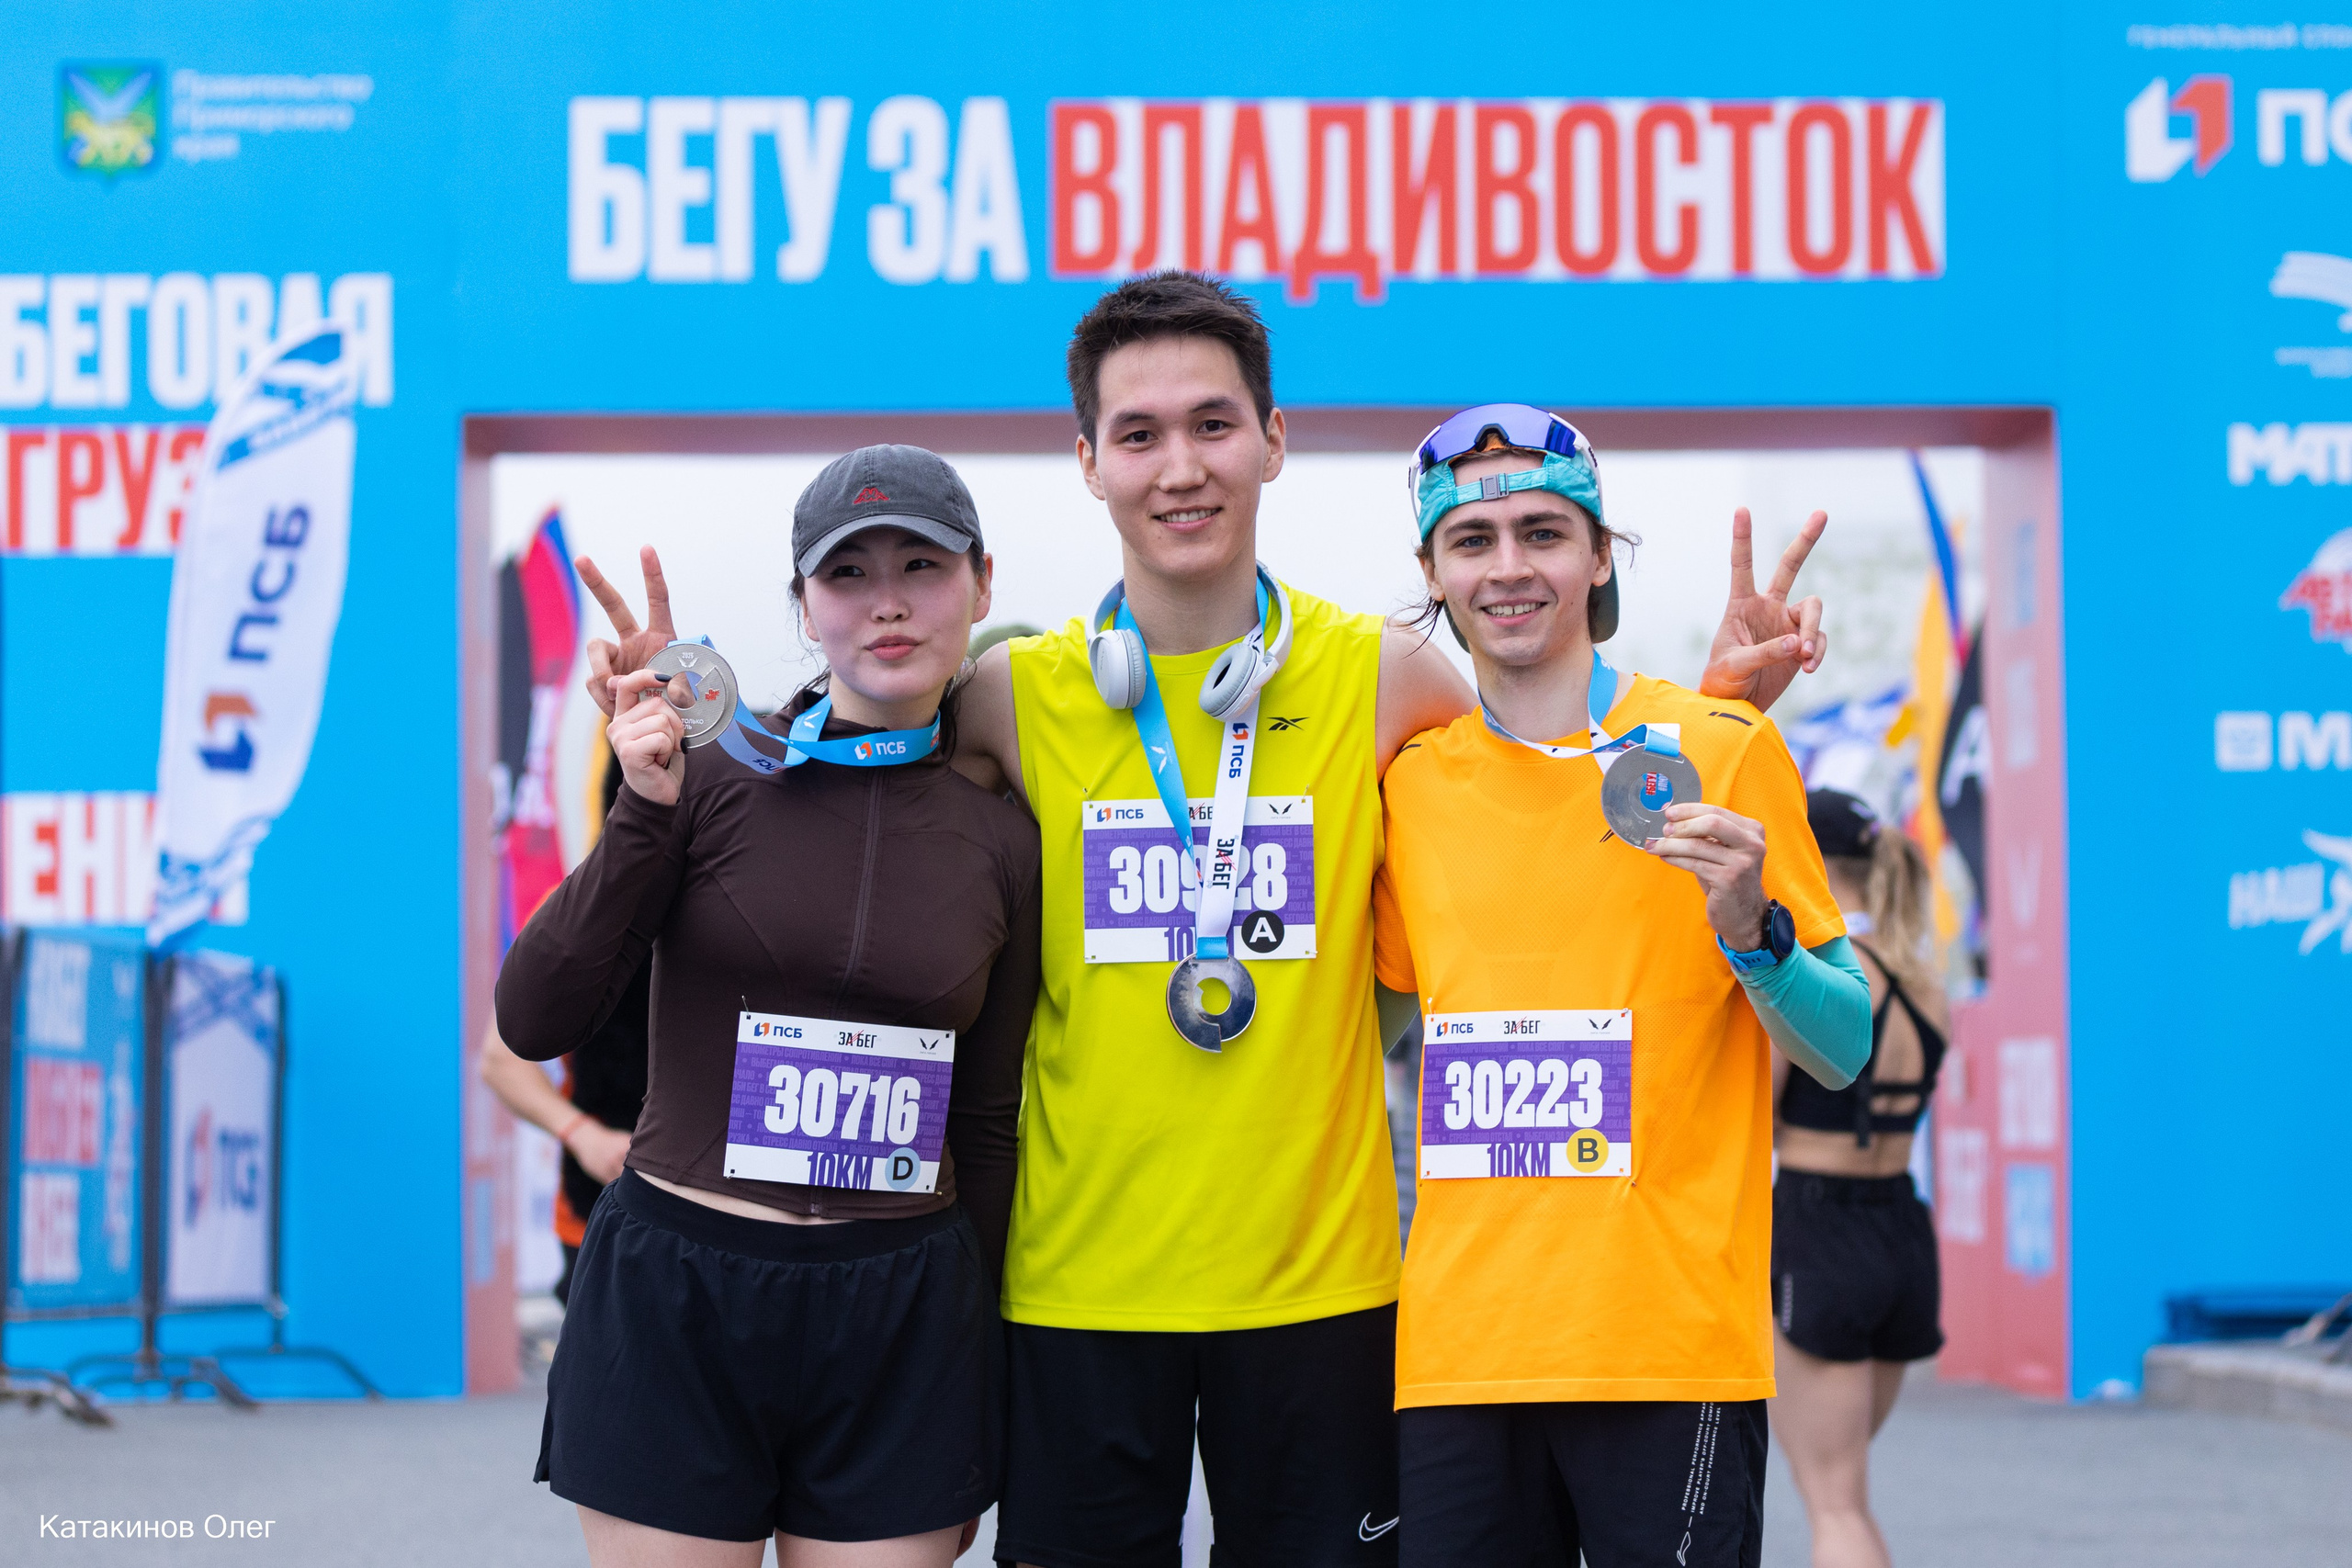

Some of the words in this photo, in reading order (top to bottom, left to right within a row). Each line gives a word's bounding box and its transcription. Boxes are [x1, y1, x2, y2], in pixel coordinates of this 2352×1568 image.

[568, 96, 853, 284] БЕГУ
[867, 95, 1030, 285] ЗА
[1051, 101, 1940, 304] ВЛАДИВОСТОК
[227, 502, 313, 663] ПСБ
[876, 741, 906, 755] ПСБ
[1228, 744, 1245, 778] ПСБ
[1115, 808, 1144, 819] ПСБ
[1199, 807, 1213, 819] БЕ
[1250, 917, 1276, 943] A
[773, 1026, 802, 1039] ПСБ
[1451, 1023, 1474, 1034] ПСБ
[763, 1065, 922, 1145] 30716
[1444, 1058, 1603, 1130] 30223
[1577, 1138, 1599, 1163] B
[892, 1156, 913, 1181] D
[1681, 1468, 1695, 1510] PROFESSIONAL
[1691, 1423, 1703, 1465] PERFORMANCE
[1690, 1486, 1700, 1513] IMPROVE
[1697, 1458, 1705, 1484] PLAYER'S
[1702, 1424, 1711, 1455] OFF-COURT
[1702, 1470, 1711, 1500] ON-COURT
[1708, 1427, 1718, 1468] PERFORMANCE
